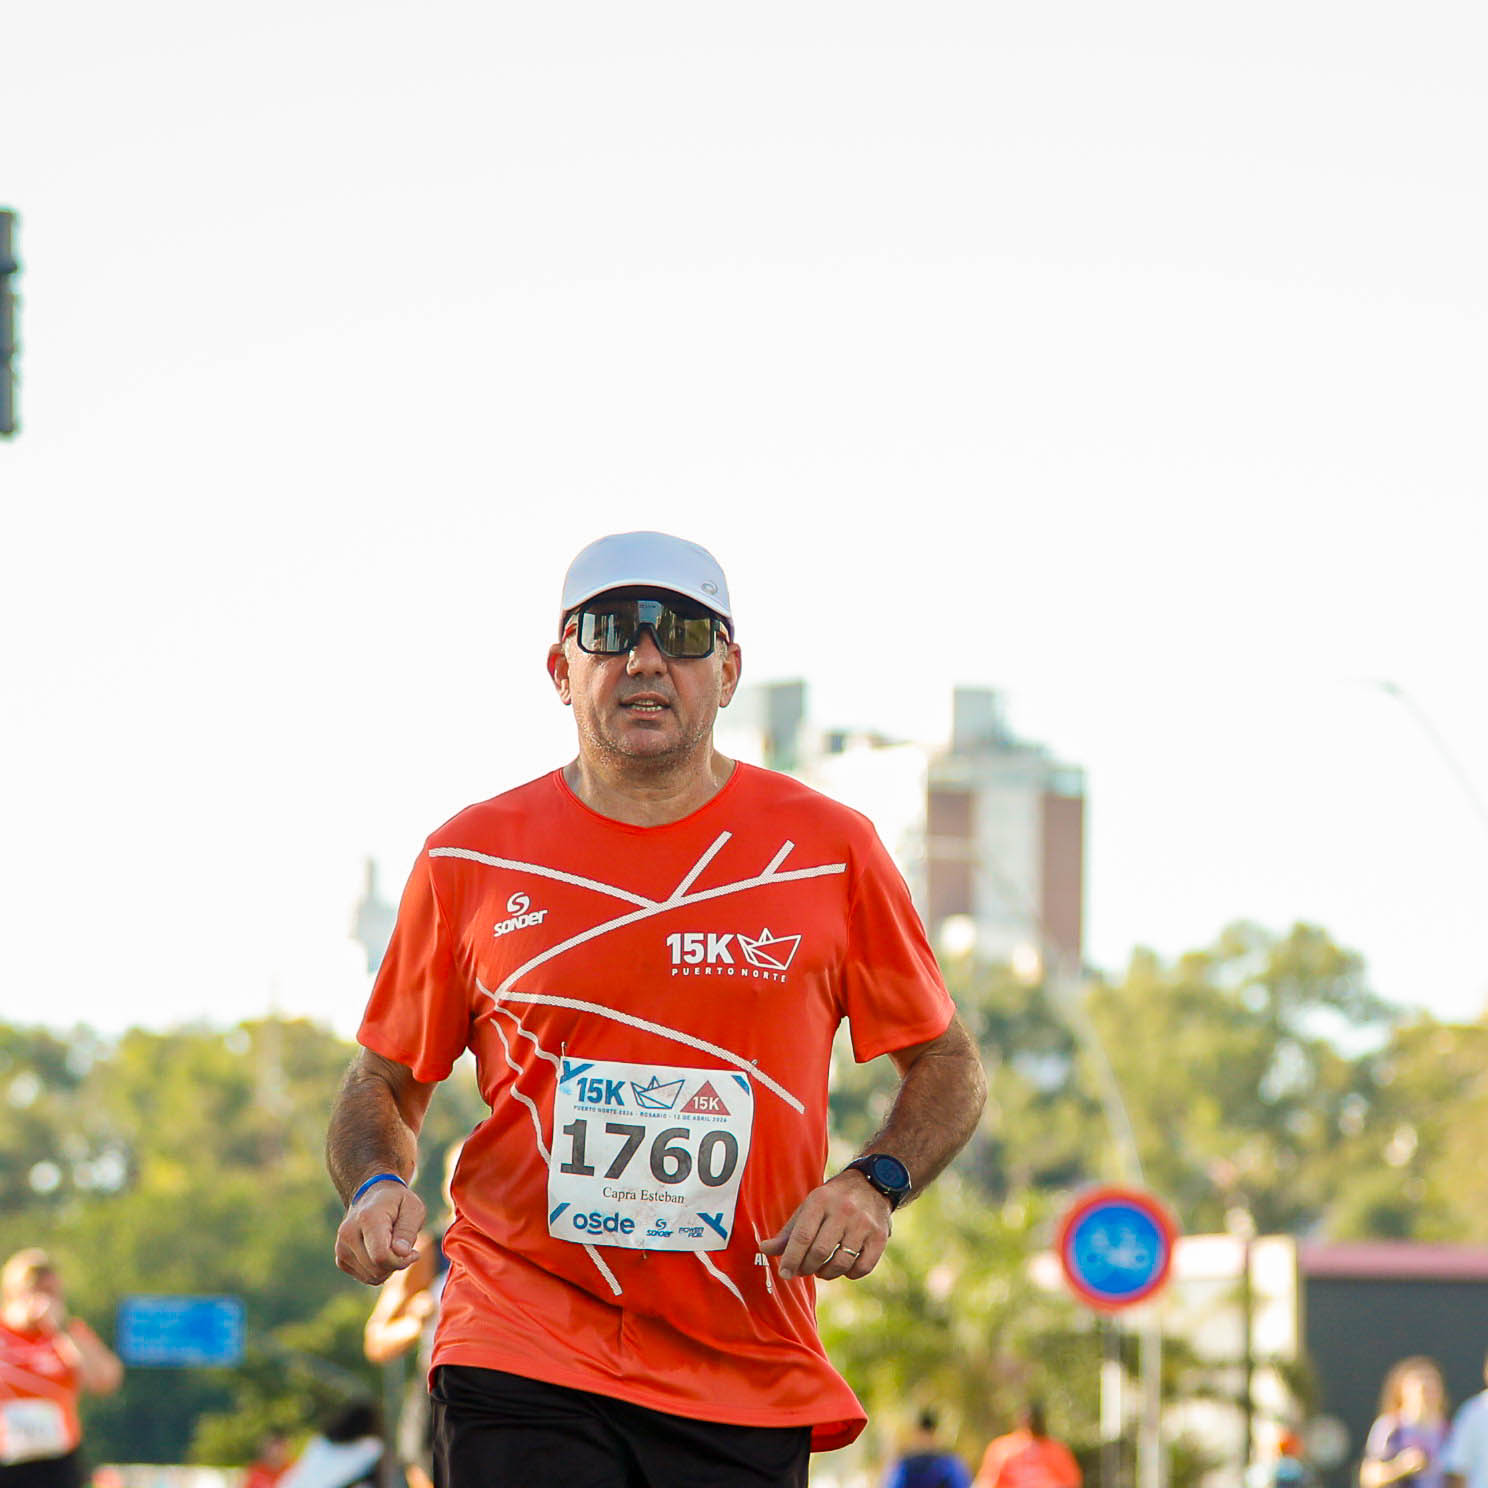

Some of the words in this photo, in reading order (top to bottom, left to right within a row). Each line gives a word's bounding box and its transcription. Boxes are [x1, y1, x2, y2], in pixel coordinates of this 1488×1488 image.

[666, 932, 735, 965] 15K
[671, 967, 735, 976] PUERTO
[741, 968, 787, 983] NORTE
[577, 1078, 625, 1106] 15K
[692, 1095, 721, 1112] 15K
[560, 1118, 739, 1187] 1760
[602, 1186, 637, 1202] Capra
[640, 1189, 685, 1204] Esteban
[573, 1212, 635, 1235] osde
